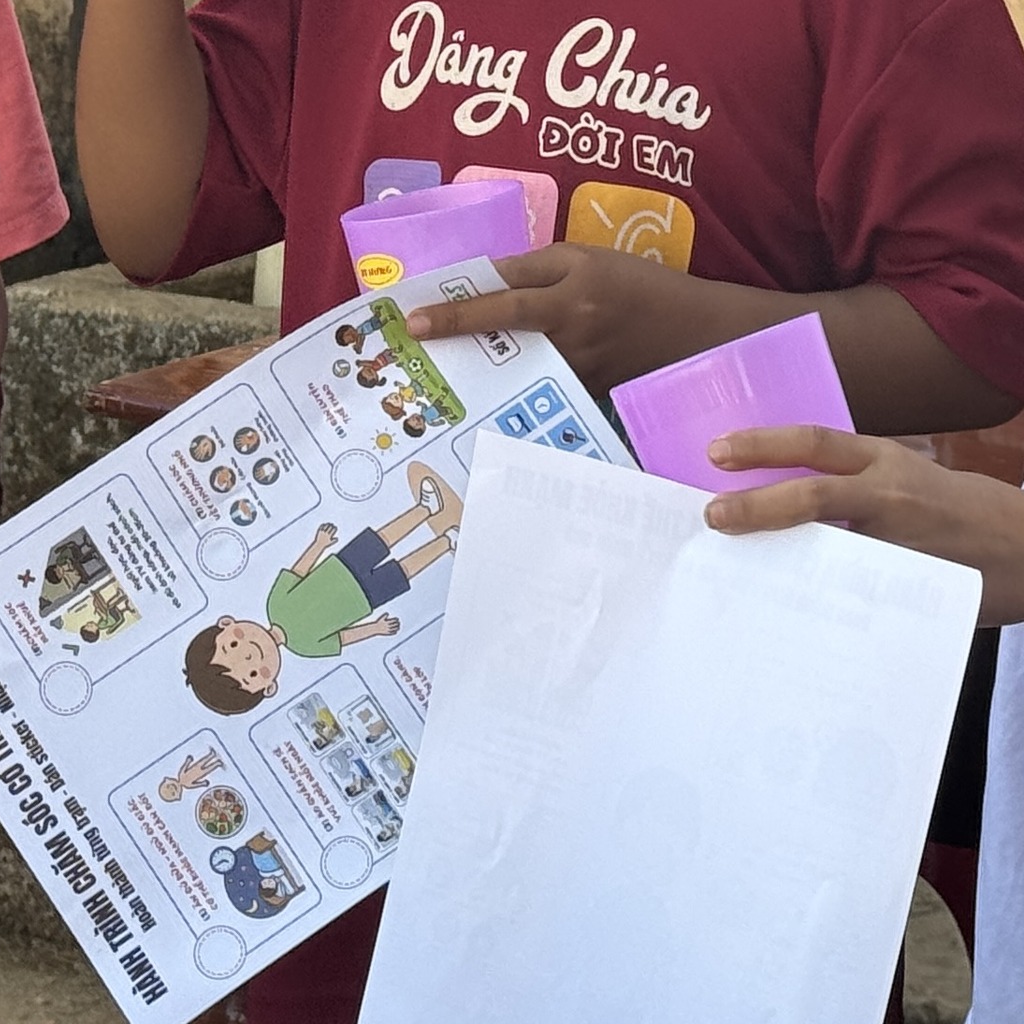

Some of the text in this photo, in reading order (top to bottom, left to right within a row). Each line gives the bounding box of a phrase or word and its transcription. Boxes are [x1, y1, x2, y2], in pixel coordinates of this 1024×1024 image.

[545, 17, 711, 130] Chúa
[538, 112, 695, 187] ĐỜI EM
[12, 720, 48, 765] sticker
[42, 763, 65, 792] Dán
[19, 792, 58, 835] SÓC
[64, 797, 90, 831] trạm
[44, 831, 96, 894] CHĂM
[84, 827, 111, 862] từng
[104, 858, 135, 899] thành
[83, 889, 133, 953] TRÌNH
[129, 896, 156, 933] Hoàn
[119, 945, 167, 1005] HÀNH
